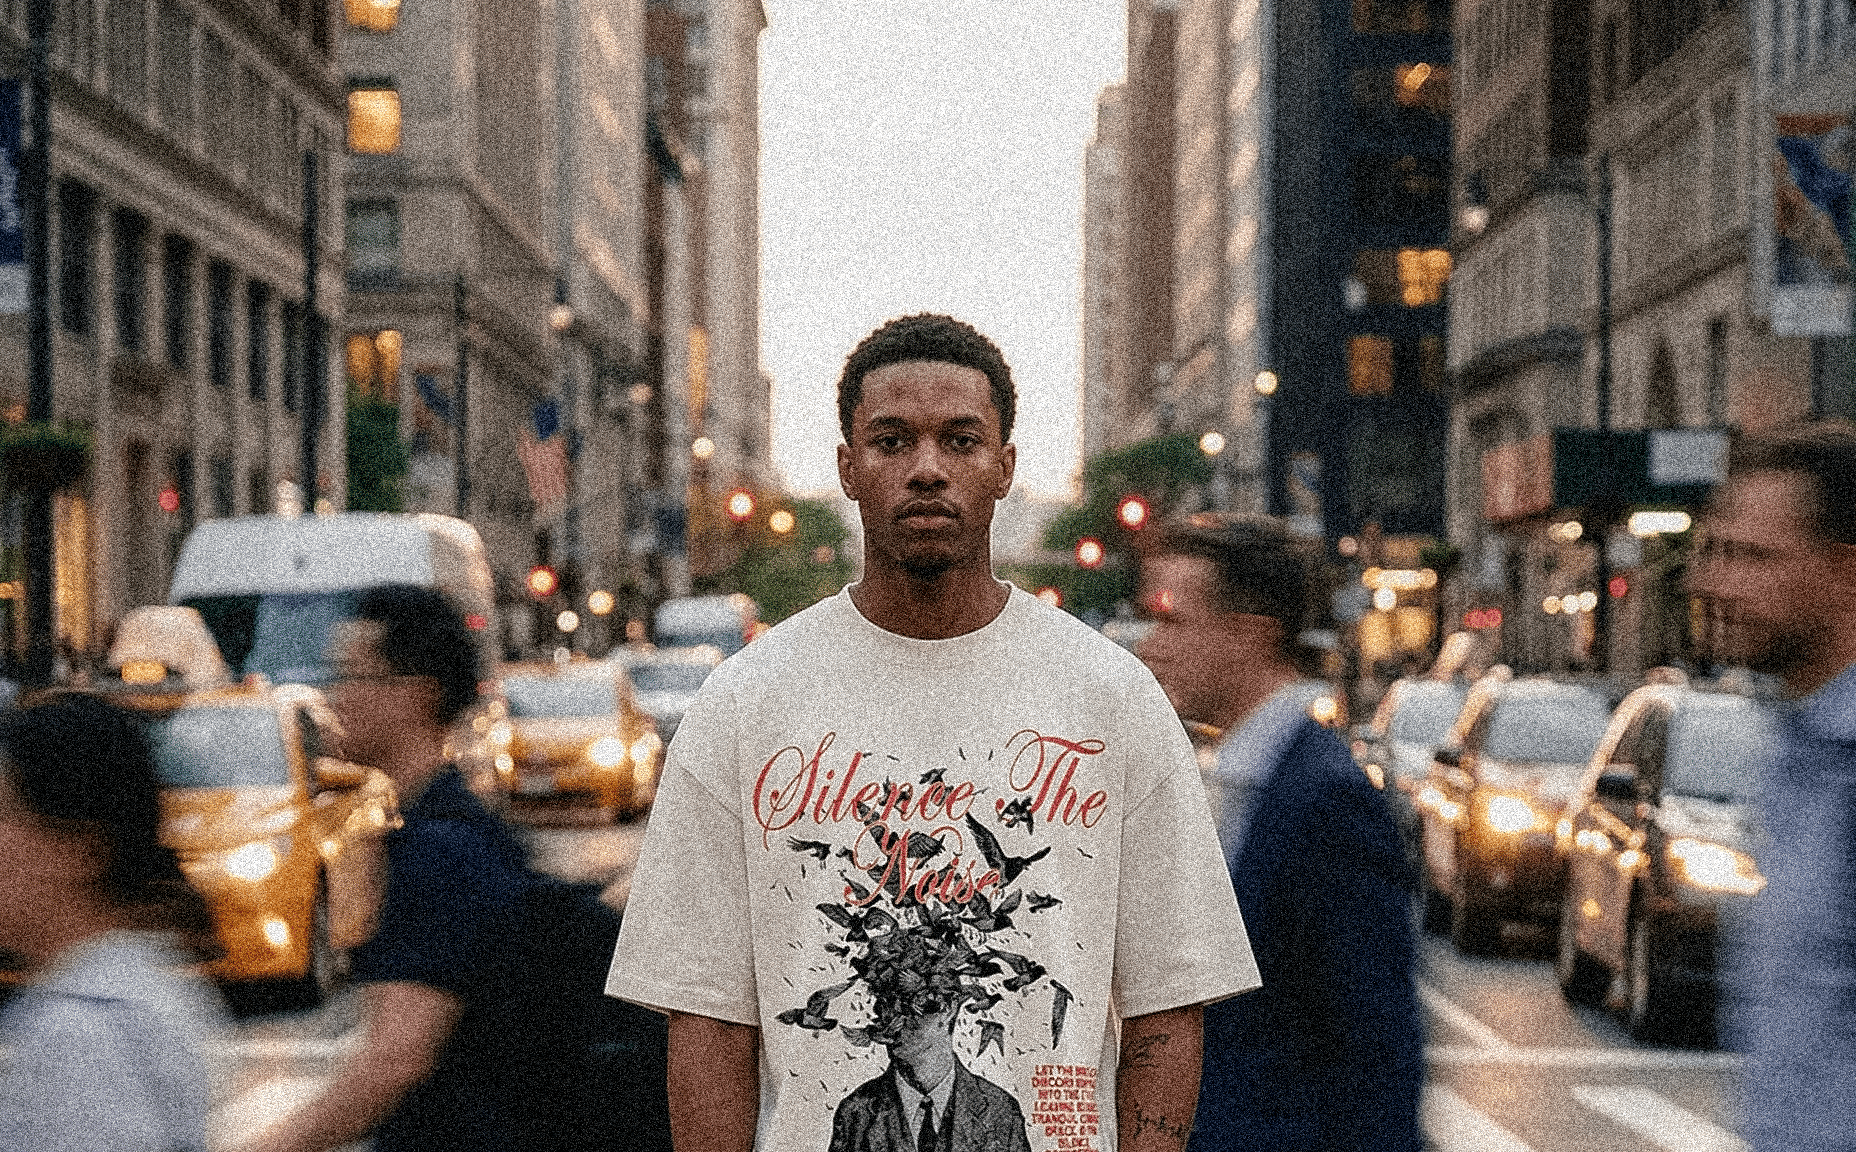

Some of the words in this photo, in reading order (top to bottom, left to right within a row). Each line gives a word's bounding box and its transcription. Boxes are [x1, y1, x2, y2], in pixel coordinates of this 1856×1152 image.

[753, 731, 977, 851] Silence
[995, 729, 1108, 828] The
[843, 822, 1002, 906] Noise
